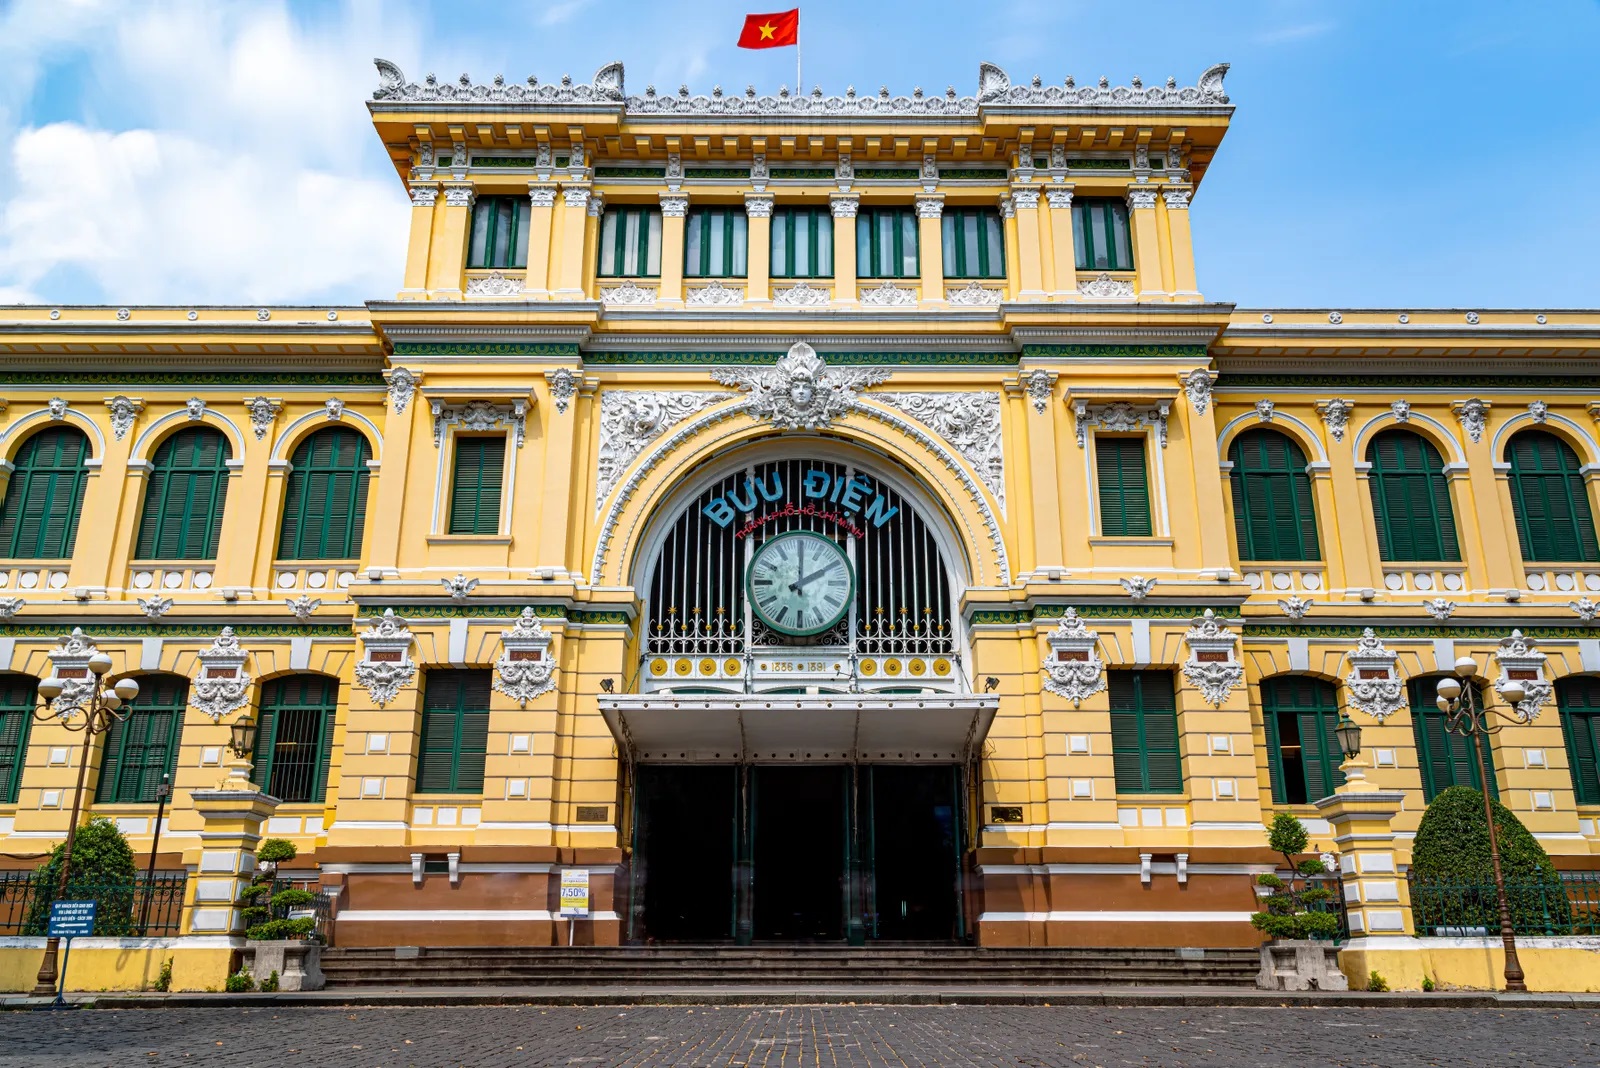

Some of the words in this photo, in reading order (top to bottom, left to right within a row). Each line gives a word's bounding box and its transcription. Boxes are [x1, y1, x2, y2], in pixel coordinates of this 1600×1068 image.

[702, 471, 783, 528] BƯU
[803, 469, 899, 529] ĐIỆN
[797, 502, 815, 515] HỒ
[838, 517, 864, 539] MINH
[807, 662, 826, 672] 1891
